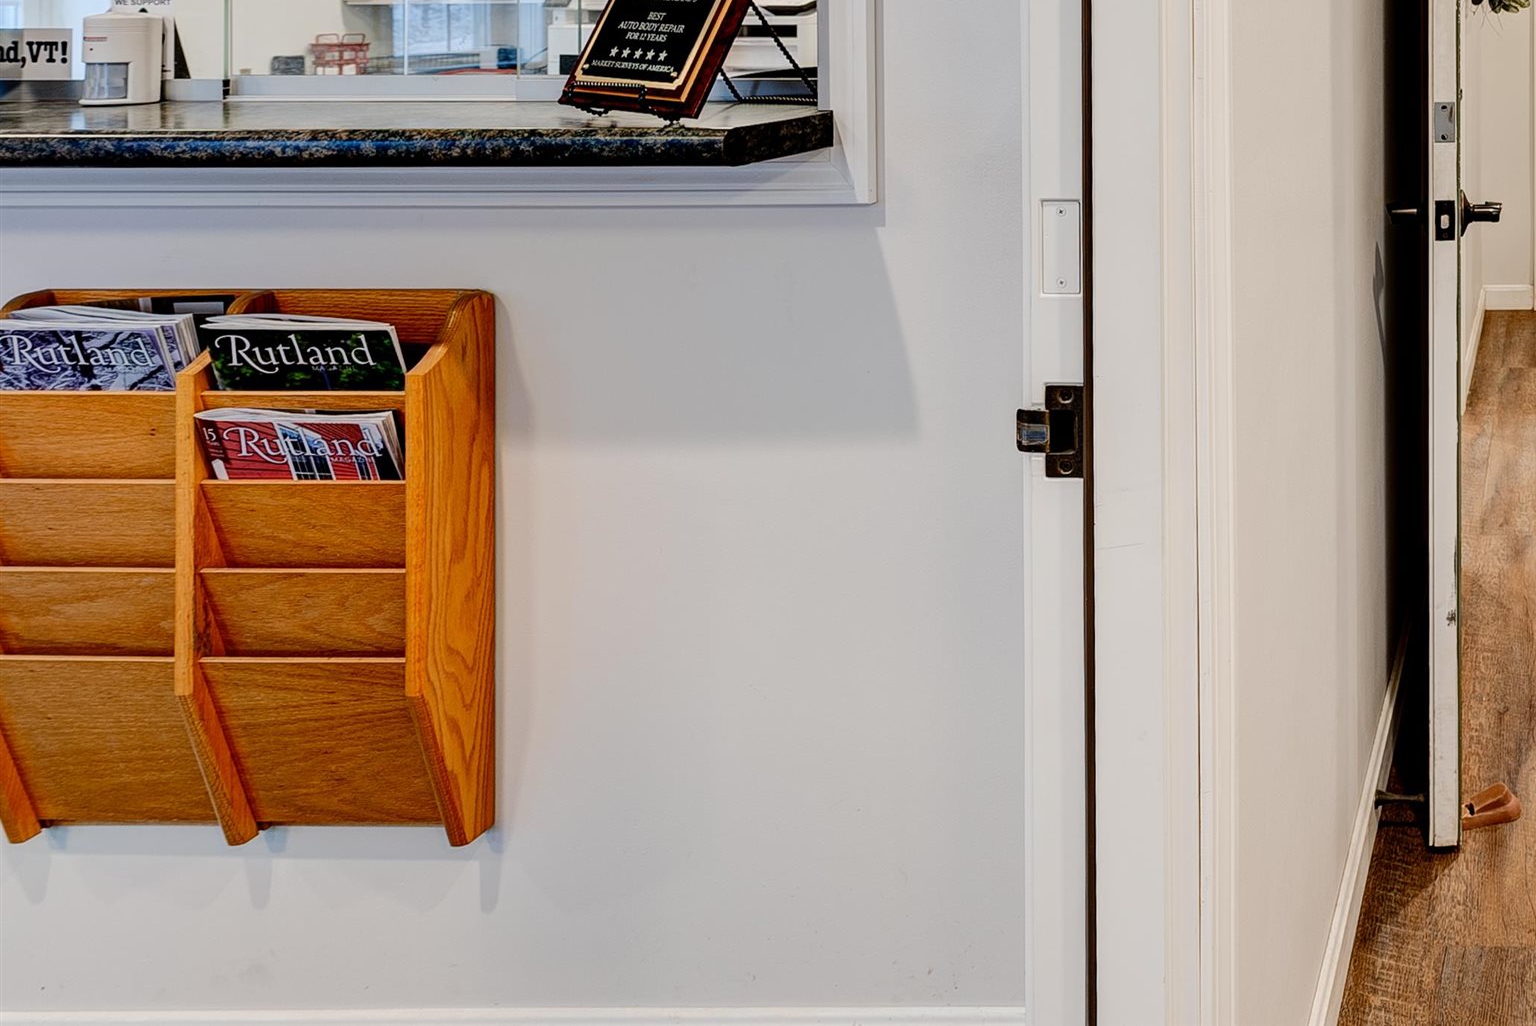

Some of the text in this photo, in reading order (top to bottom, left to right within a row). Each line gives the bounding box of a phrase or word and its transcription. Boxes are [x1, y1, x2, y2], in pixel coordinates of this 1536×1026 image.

[647, 11, 667, 21] BEST
[617, 21, 685, 34] AUTO BODY REPAIR
[625, 31, 641, 41] FOR
[646, 33, 668, 43] YEARS
[591, 59, 616, 69] MARKET
[638, 64, 648, 72] OF
[647, 64, 675, 73] AMERICA
[0, 335, 157, 373] Rutland
[214, 333, 377, 374] Rutland
[203, 427, 217, 442] 15
[222, 426, 384, 464] Rutland
